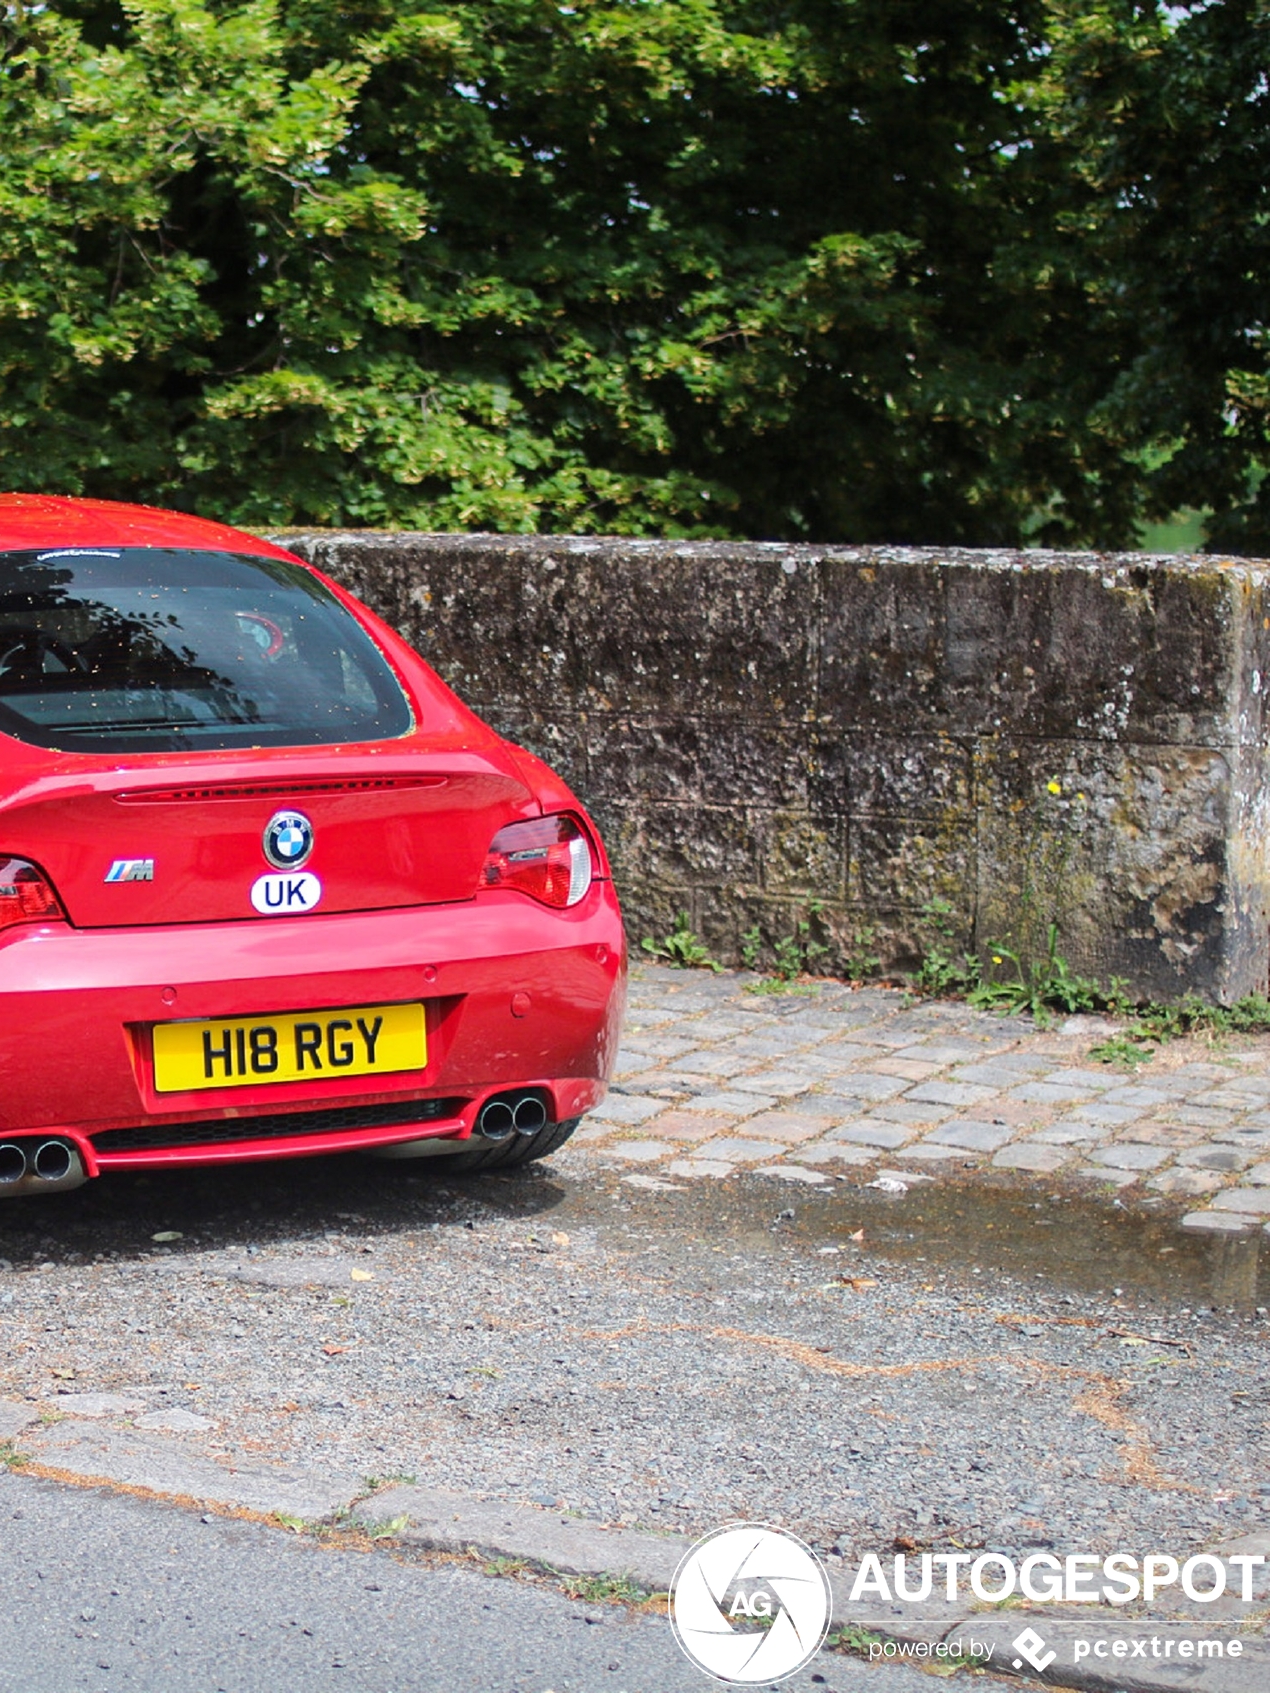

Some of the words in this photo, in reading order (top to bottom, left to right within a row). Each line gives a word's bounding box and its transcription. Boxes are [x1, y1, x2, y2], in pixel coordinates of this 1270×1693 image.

[273, 818, 308, 836] BMW
[264, 878, 307, 907] UK
[202, 1026, 278, 1078] H18
[293, 1016, 383, 1071] RGY
